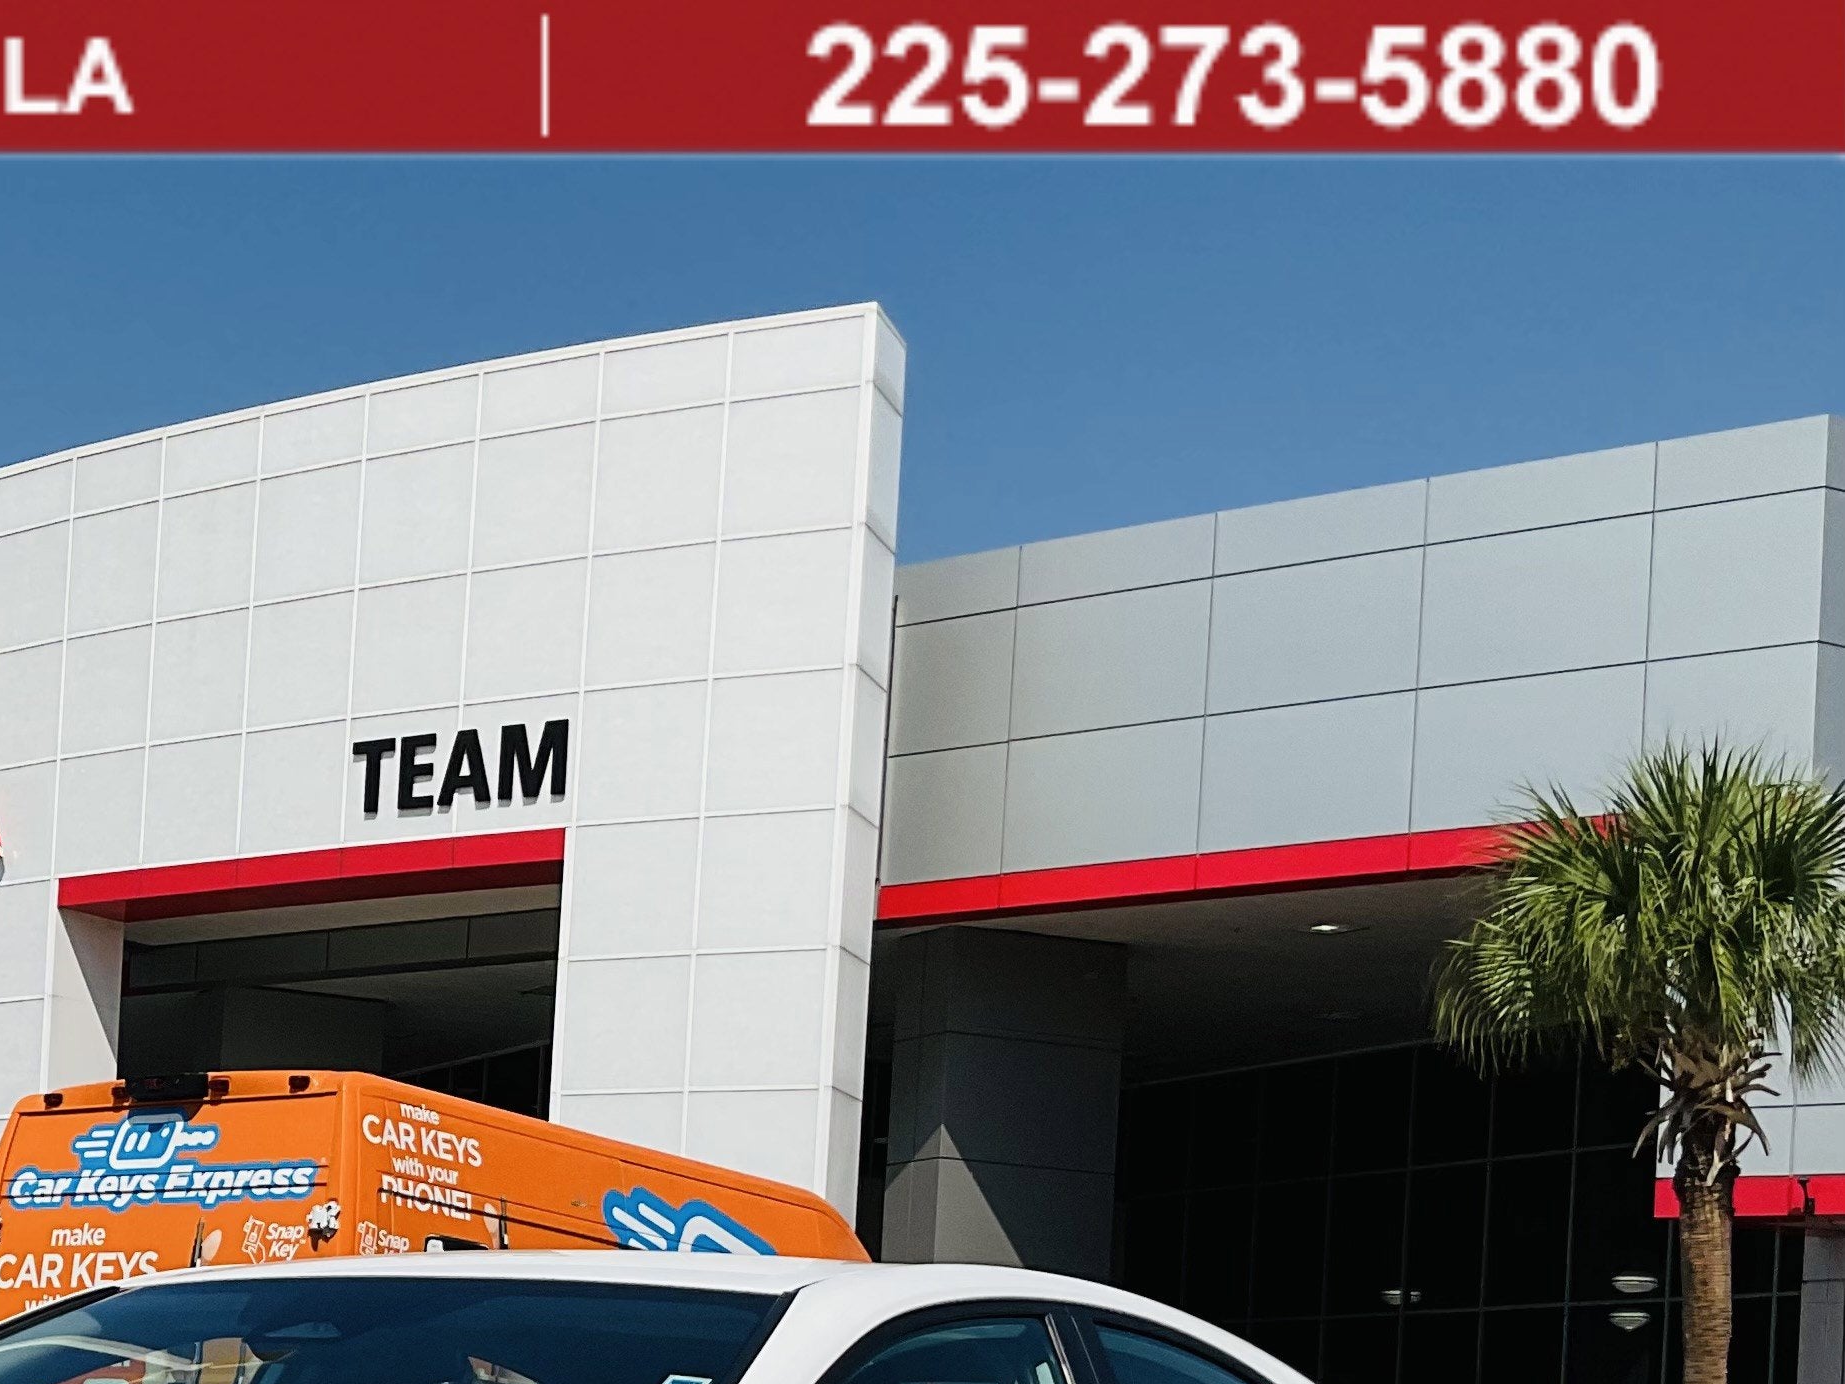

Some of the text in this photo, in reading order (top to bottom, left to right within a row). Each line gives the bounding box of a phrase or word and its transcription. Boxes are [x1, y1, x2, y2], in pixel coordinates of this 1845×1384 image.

[352, 719, 569, 817] TEAM
[400, 1103, 440, 1125] make
[362, 1114, 483, 1167] CAR KEYS
[10, 1164, 315, 1206] Car Keys Express
[392, 1156, 459, 1185] with your
[381, 1173, 472, 1221] PHONE!
[51, 1222, 106, 1247] make
[265, 1222, 306, 1242] Snap
[378, 1229, 410, 1254] Snap
[268, 1241, 300, 1261] Key
[70, 1251, 159, 1288] KEYS
